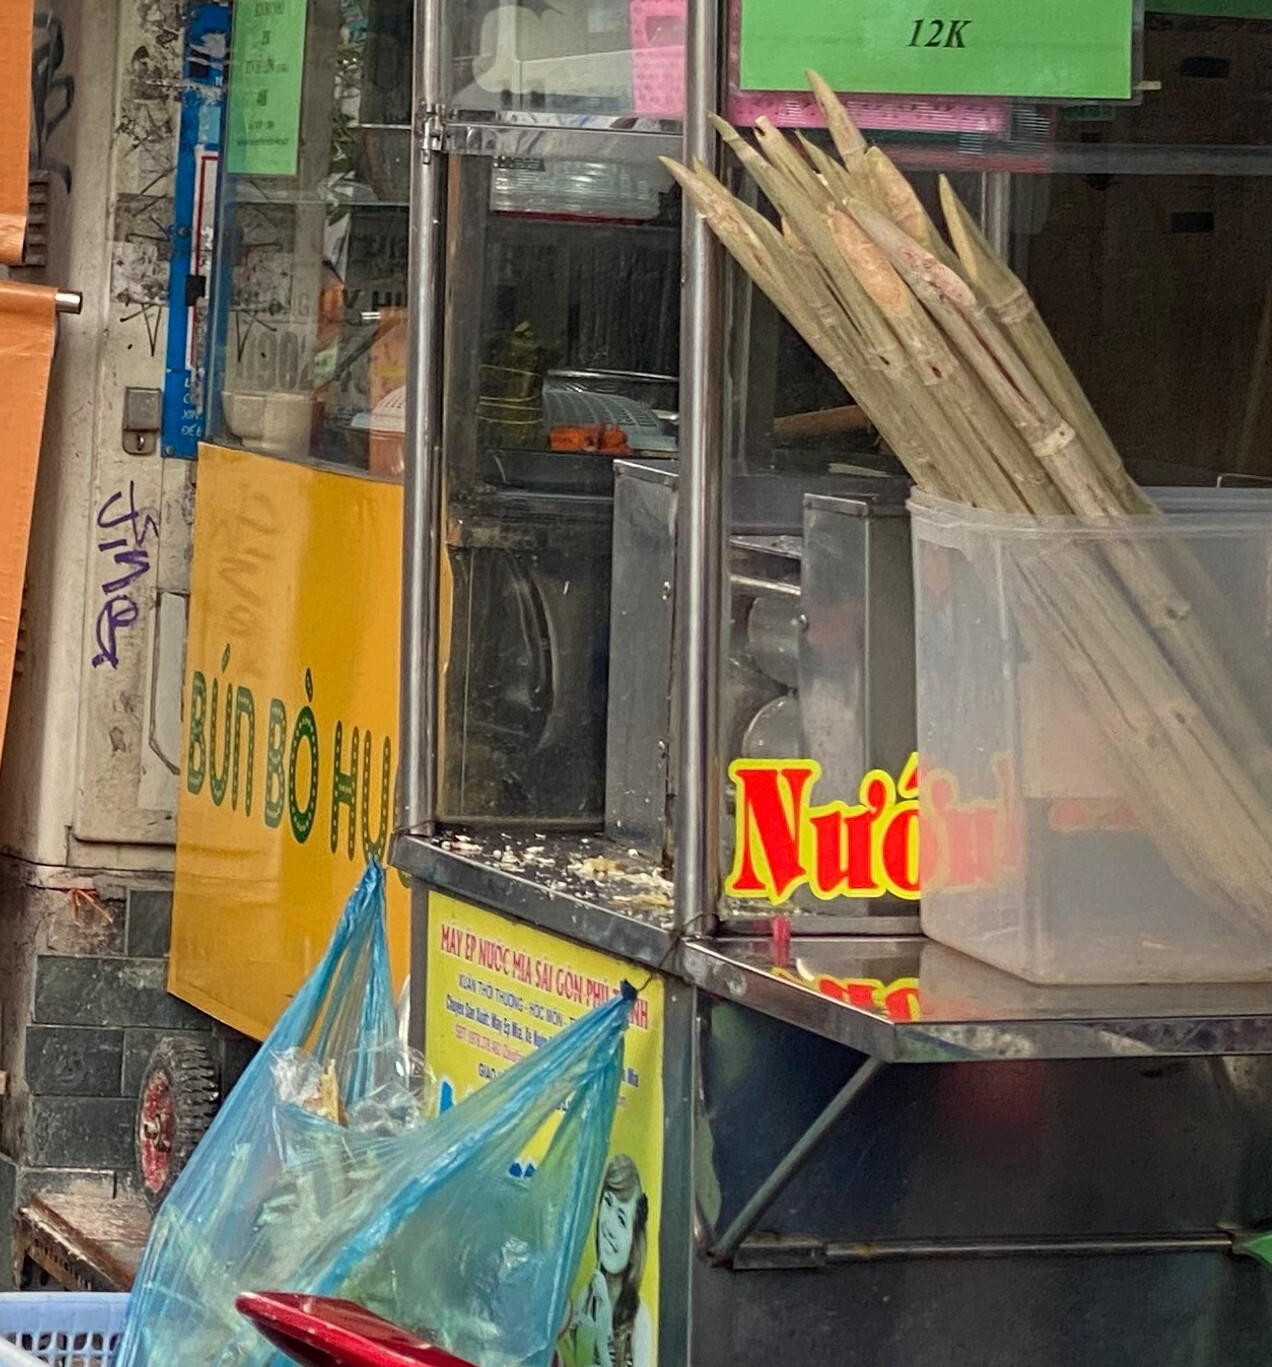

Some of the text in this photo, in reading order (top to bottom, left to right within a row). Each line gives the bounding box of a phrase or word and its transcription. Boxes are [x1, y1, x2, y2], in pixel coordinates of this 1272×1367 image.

[907, 18, 971, 48] 12K
[187, 642, 256, 818] BÚN
[329, 719, 392, 861] HU
